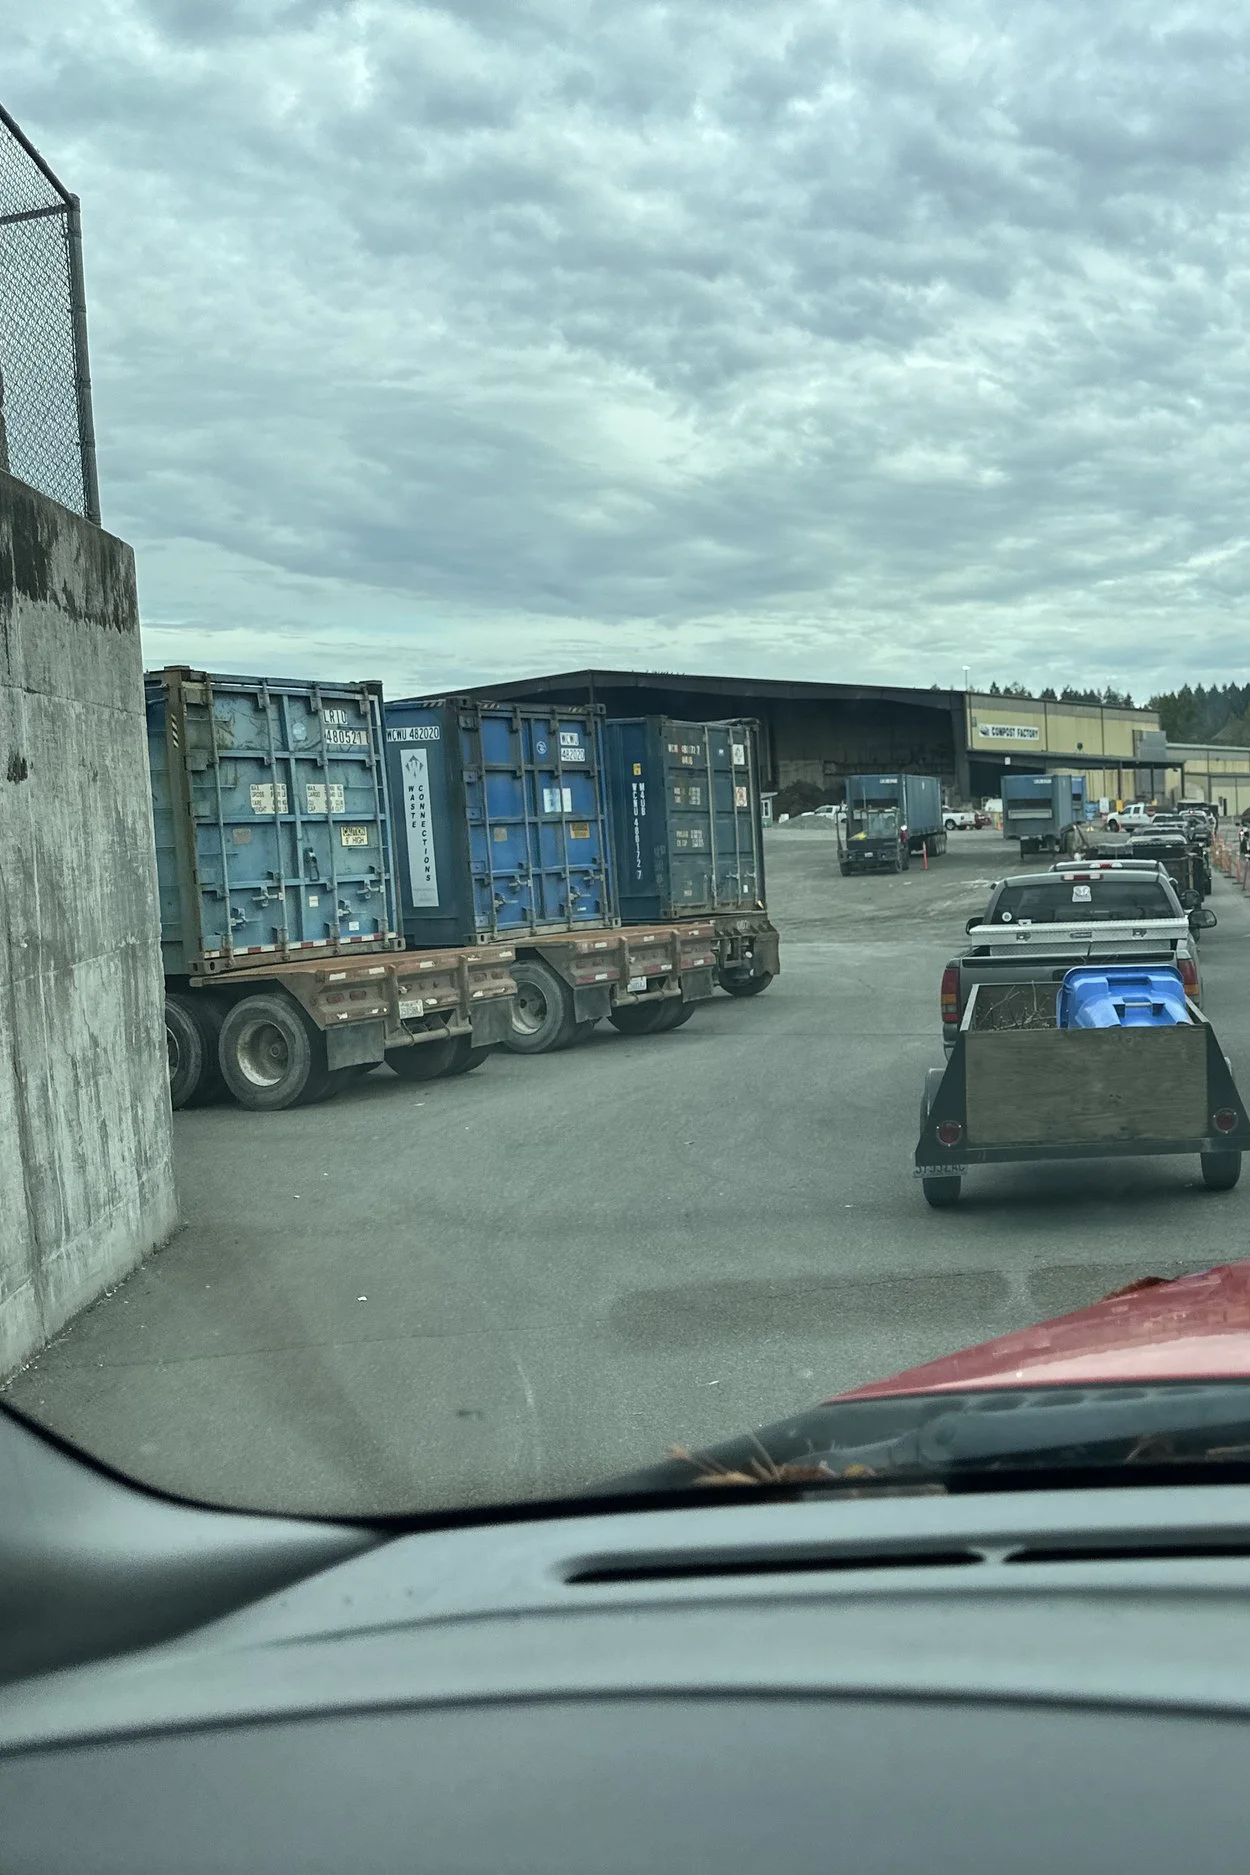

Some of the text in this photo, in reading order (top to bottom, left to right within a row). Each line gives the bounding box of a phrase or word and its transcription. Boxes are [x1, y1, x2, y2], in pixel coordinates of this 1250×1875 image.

[323, 709, 347, 724] LRIU
[326, 729, 362, 745] 480521
[409, 727, 439, 740] 482020
[991, 726, 1038, 738] COMPOST FACTORY
[561, 748, 585, 761] 482020
[408, 785, 417, 828] WASTE
[418, 785, 431, 881] CONNECTIONS
